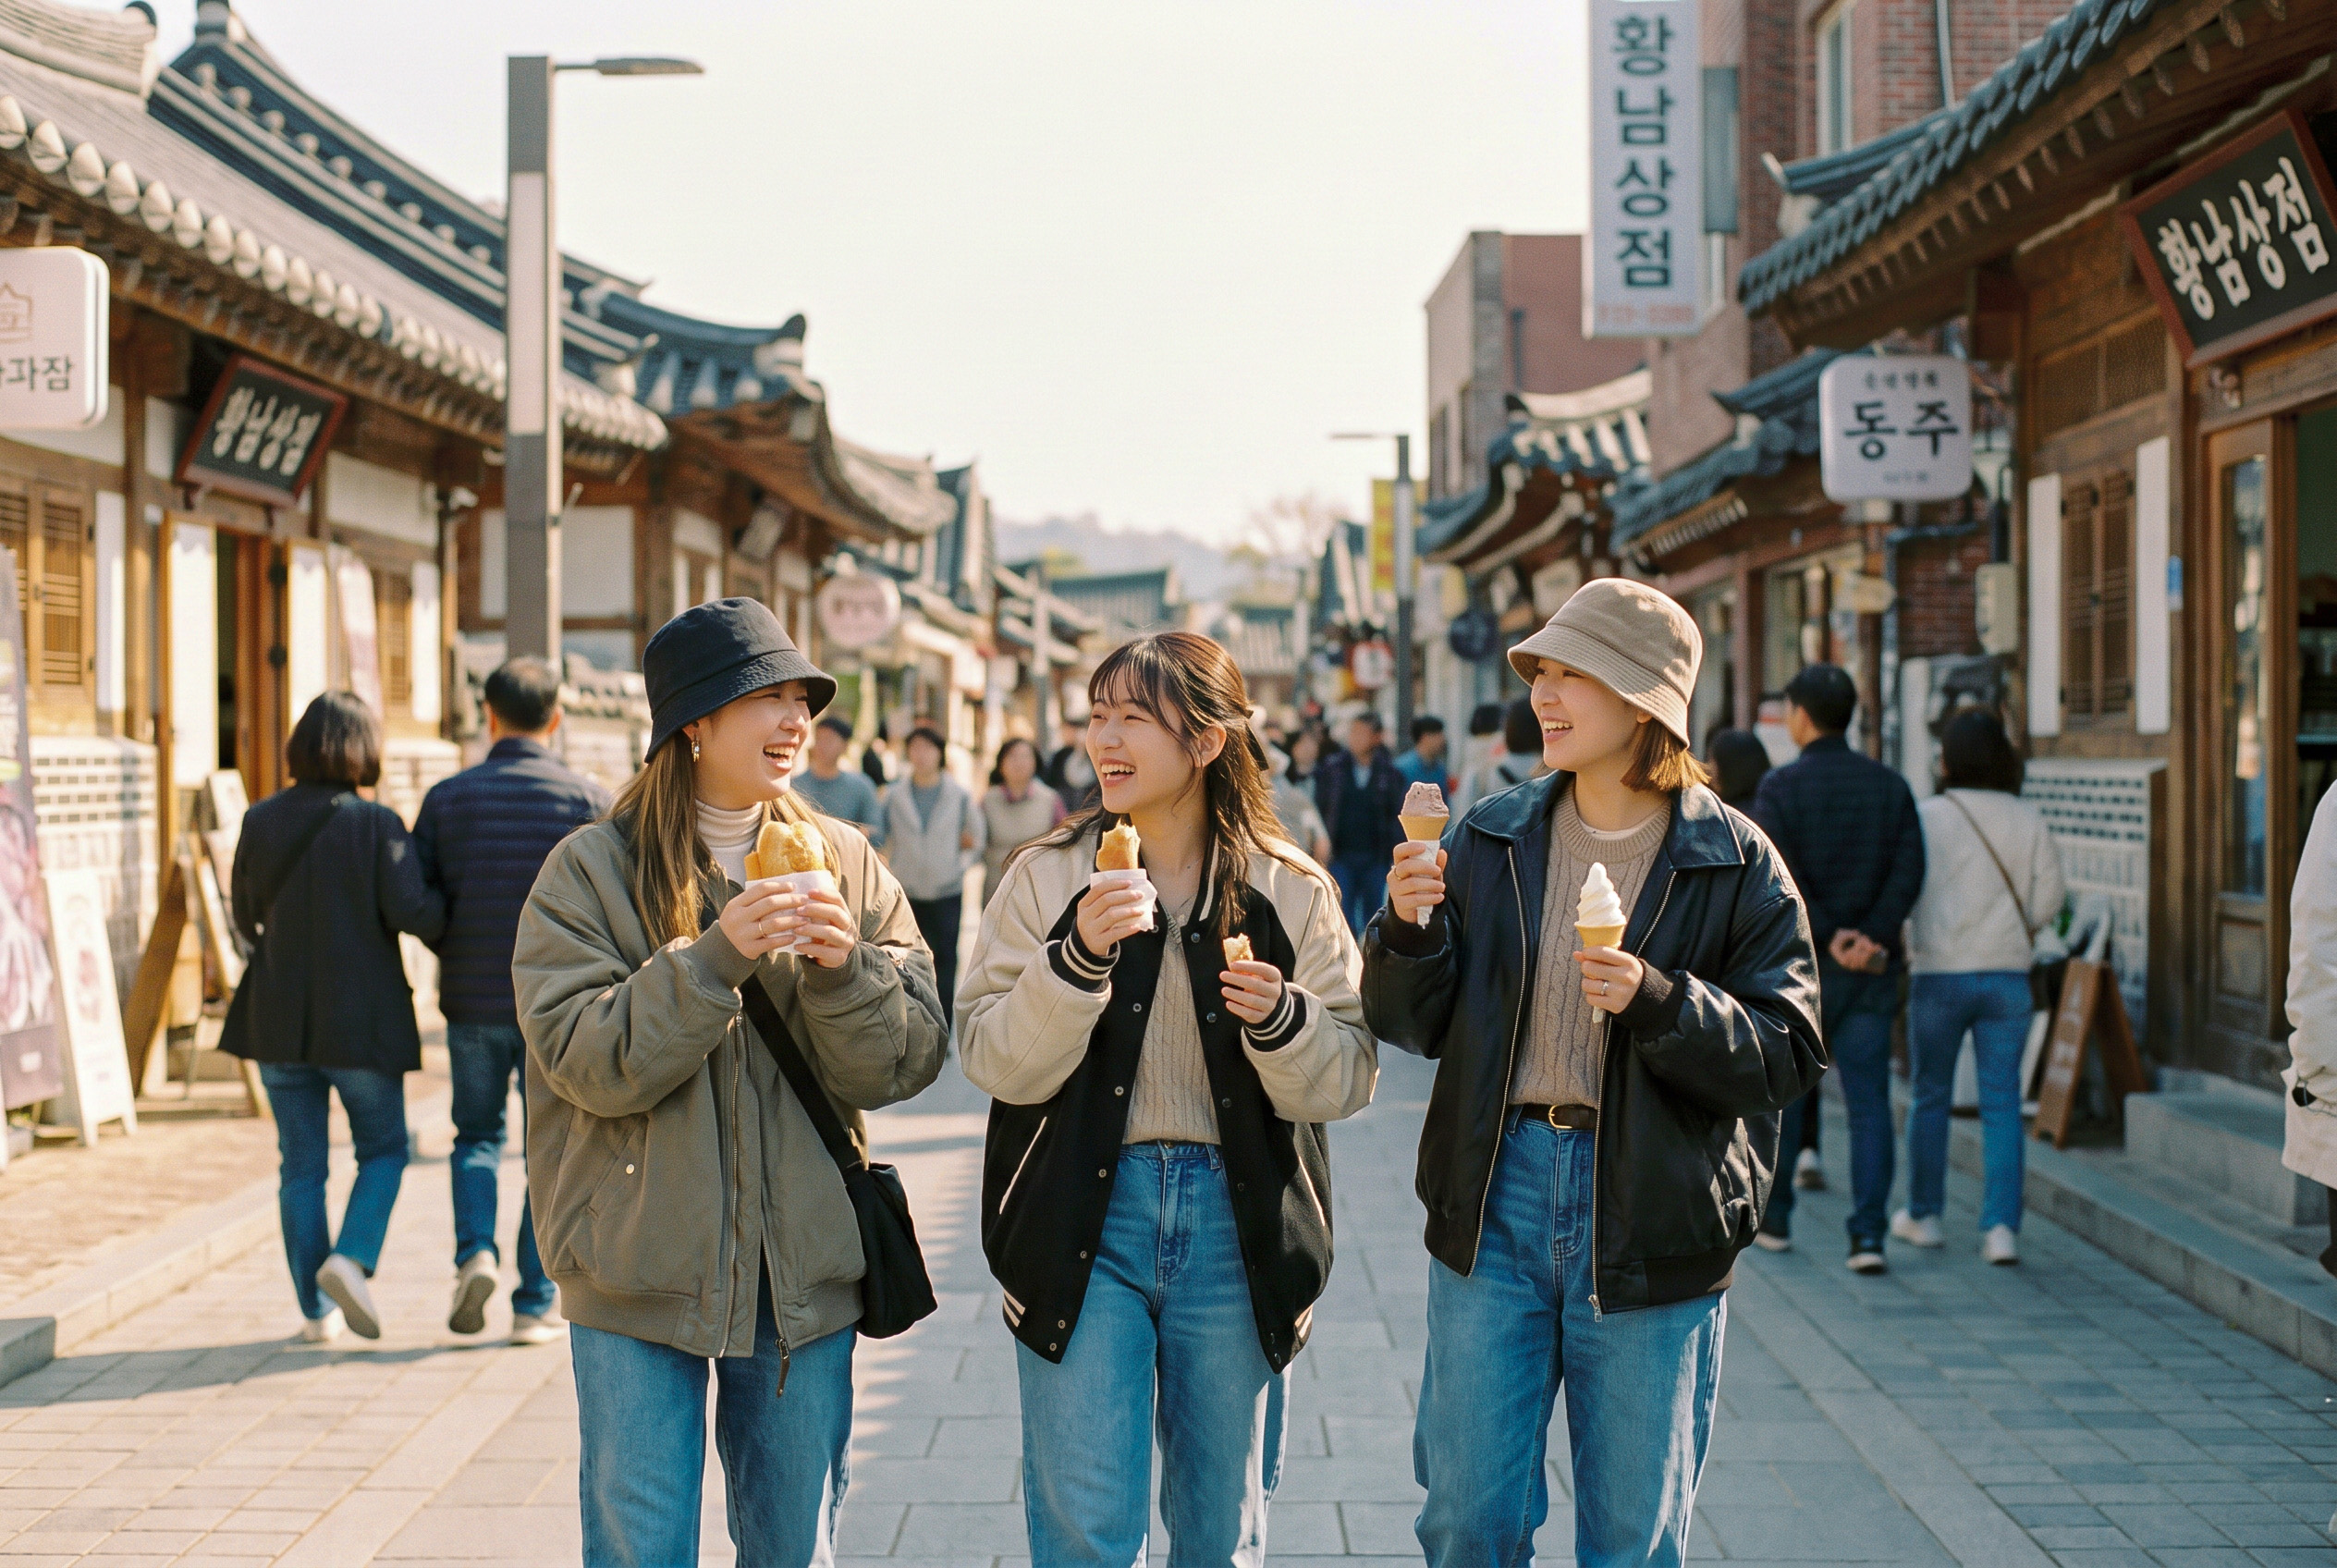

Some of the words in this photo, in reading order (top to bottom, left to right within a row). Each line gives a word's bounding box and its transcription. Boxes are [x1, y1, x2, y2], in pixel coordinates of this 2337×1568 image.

[1611, 14, 1674, 288] 황남상점
[2158, 156, 2330, 320] 황남상점
[0, 356, 73, 391] 과잠
[1844, 400, 1959, 459] 동주
